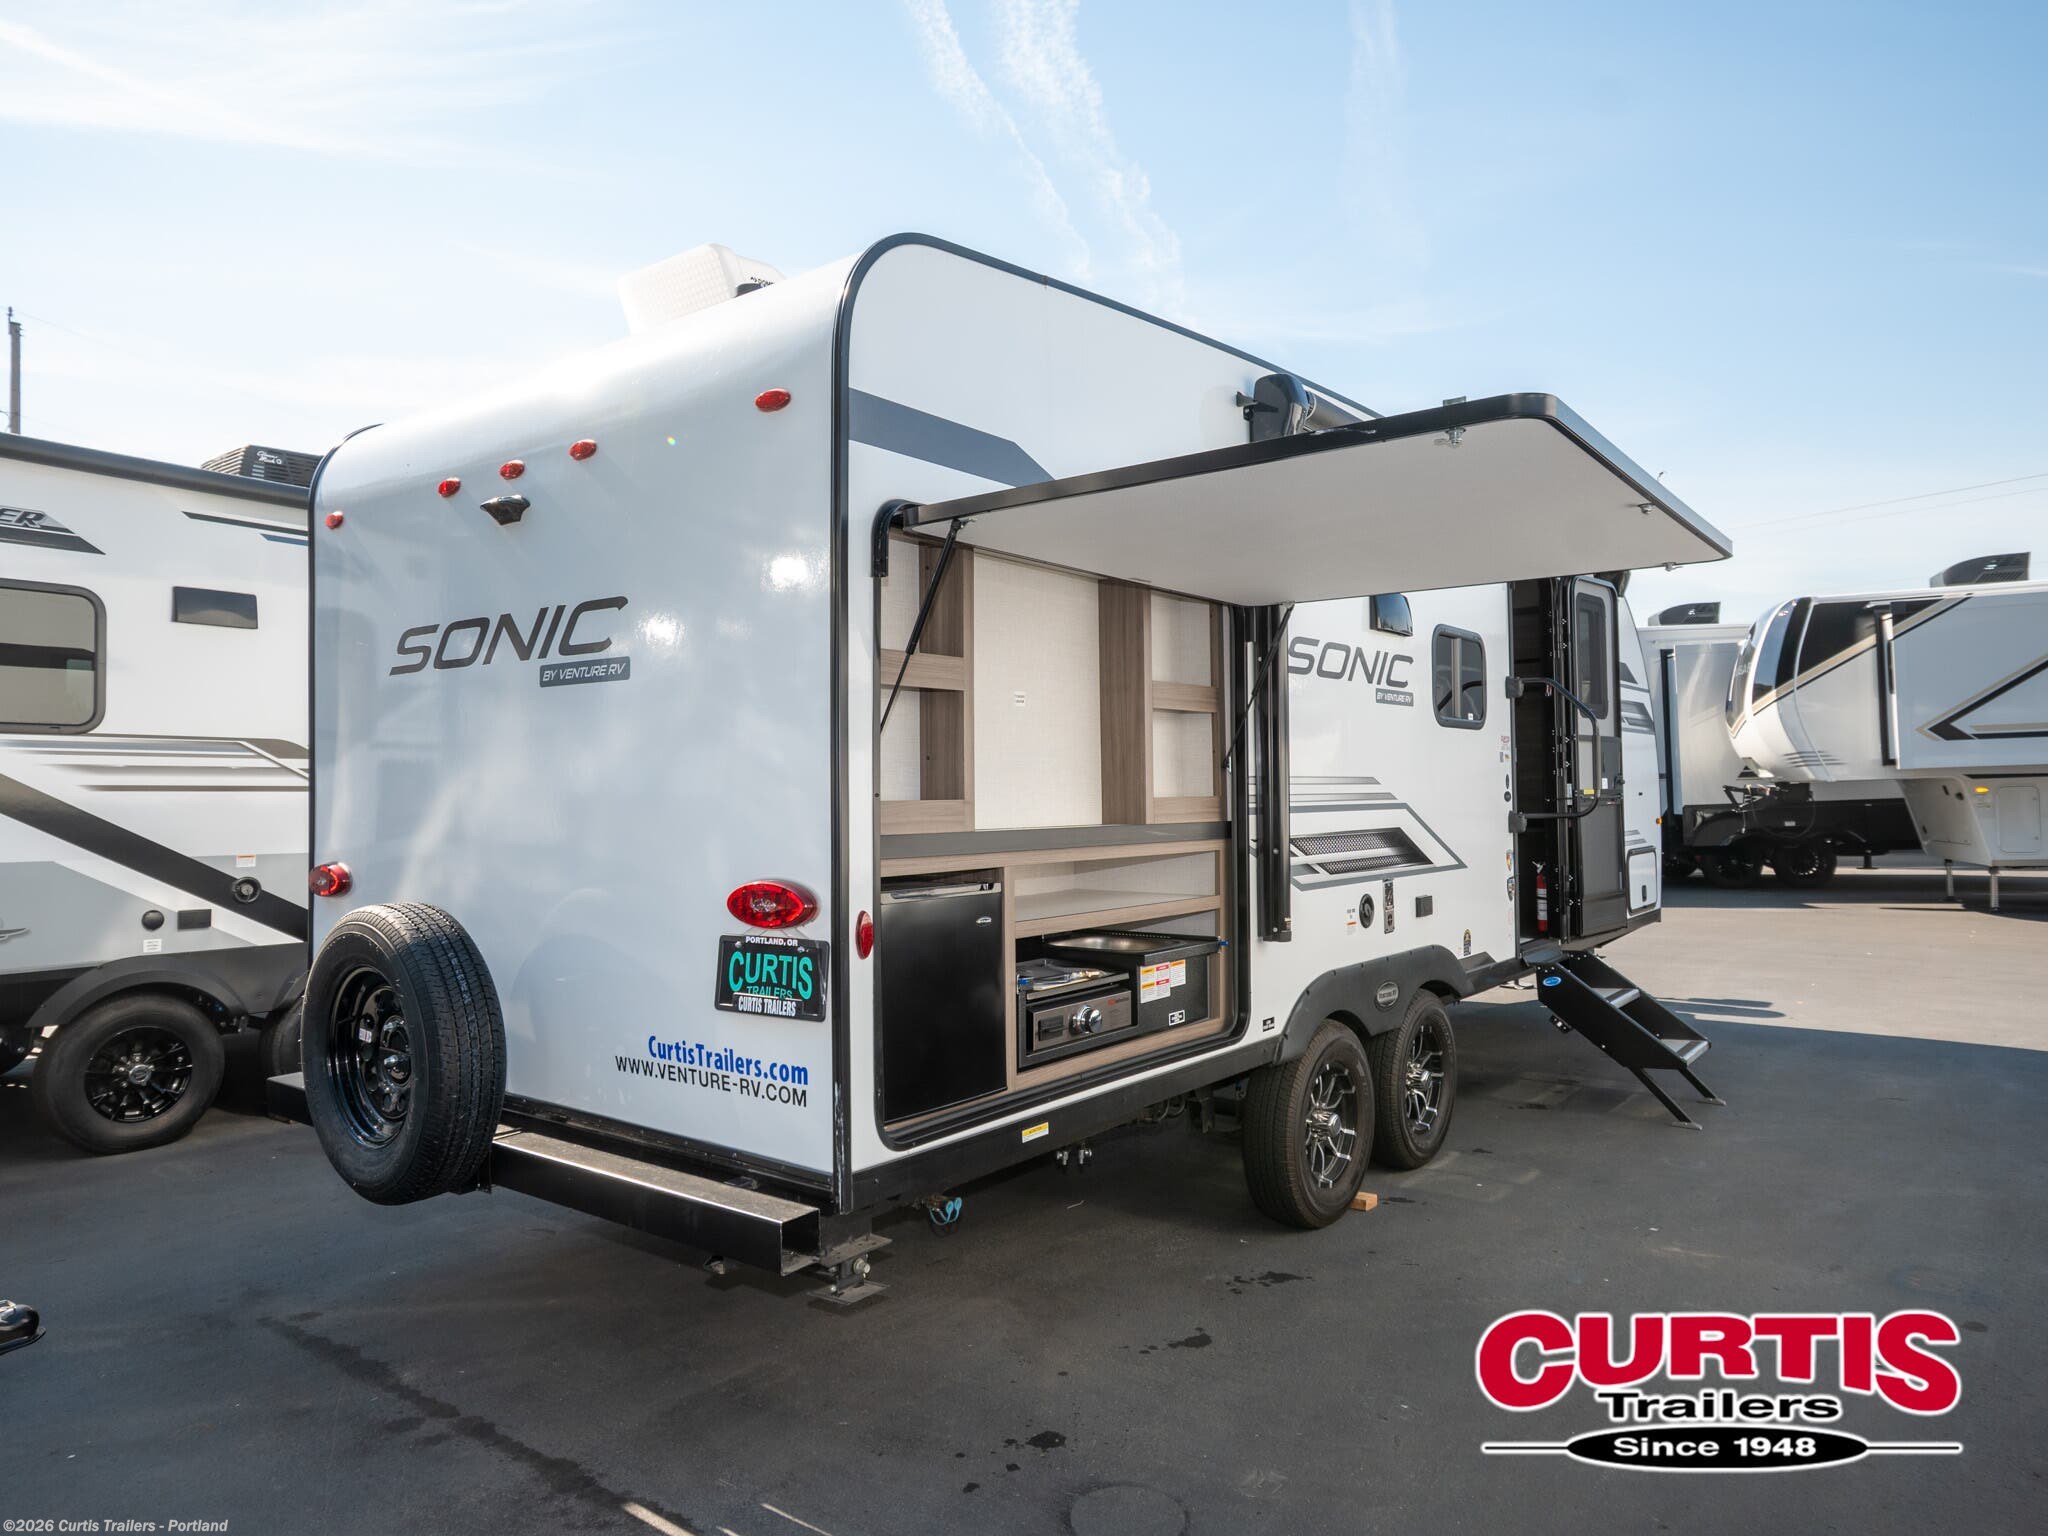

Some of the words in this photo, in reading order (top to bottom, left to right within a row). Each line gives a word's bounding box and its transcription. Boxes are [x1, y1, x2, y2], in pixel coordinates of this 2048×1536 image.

[389, 596, 628, 676] SONIC
[542, 670, 557, 681] BY
[559, 665, 607, 680] VENTURE
[608, 663, 626, 675] RV
[1287, 636, 1414, 688] SONIC
[745, 936, 786, 947] PORTLAND,
[787, 939, 798, 947] OR
[728, 951, 813, 999] CURTIS
[738, 996, 762, 1013] CURTIS
[764, 998, 797, 1016] TRAILERS
[615, 1055, 807, 1108] WWW.VENTURE-RV.COM
[648, 1035, 808, 1085] CurtisTrailers.com
